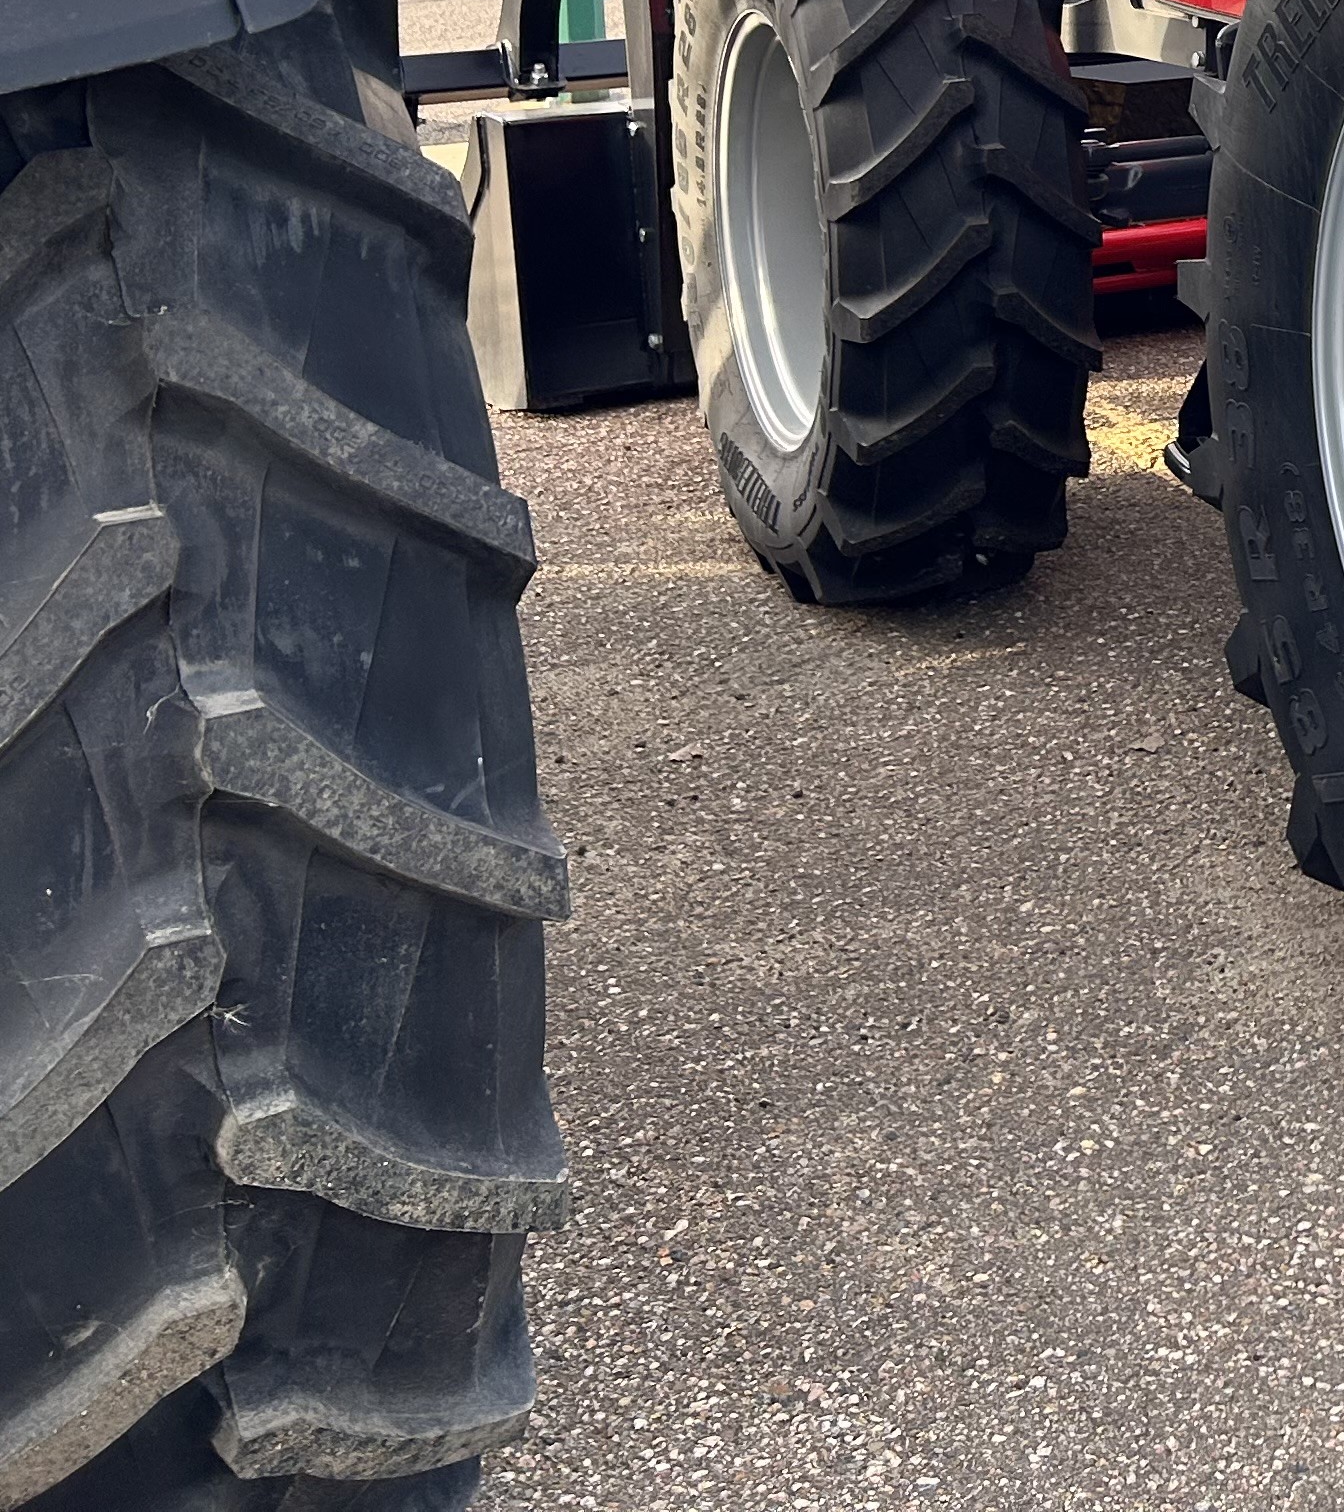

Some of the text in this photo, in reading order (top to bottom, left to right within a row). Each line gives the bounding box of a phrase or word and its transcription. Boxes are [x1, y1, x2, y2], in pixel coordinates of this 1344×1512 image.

[678, 1, 697, 72] 28
[1217, 318, 1257, 471] 38
[1236, 502, 1280, 583] R
